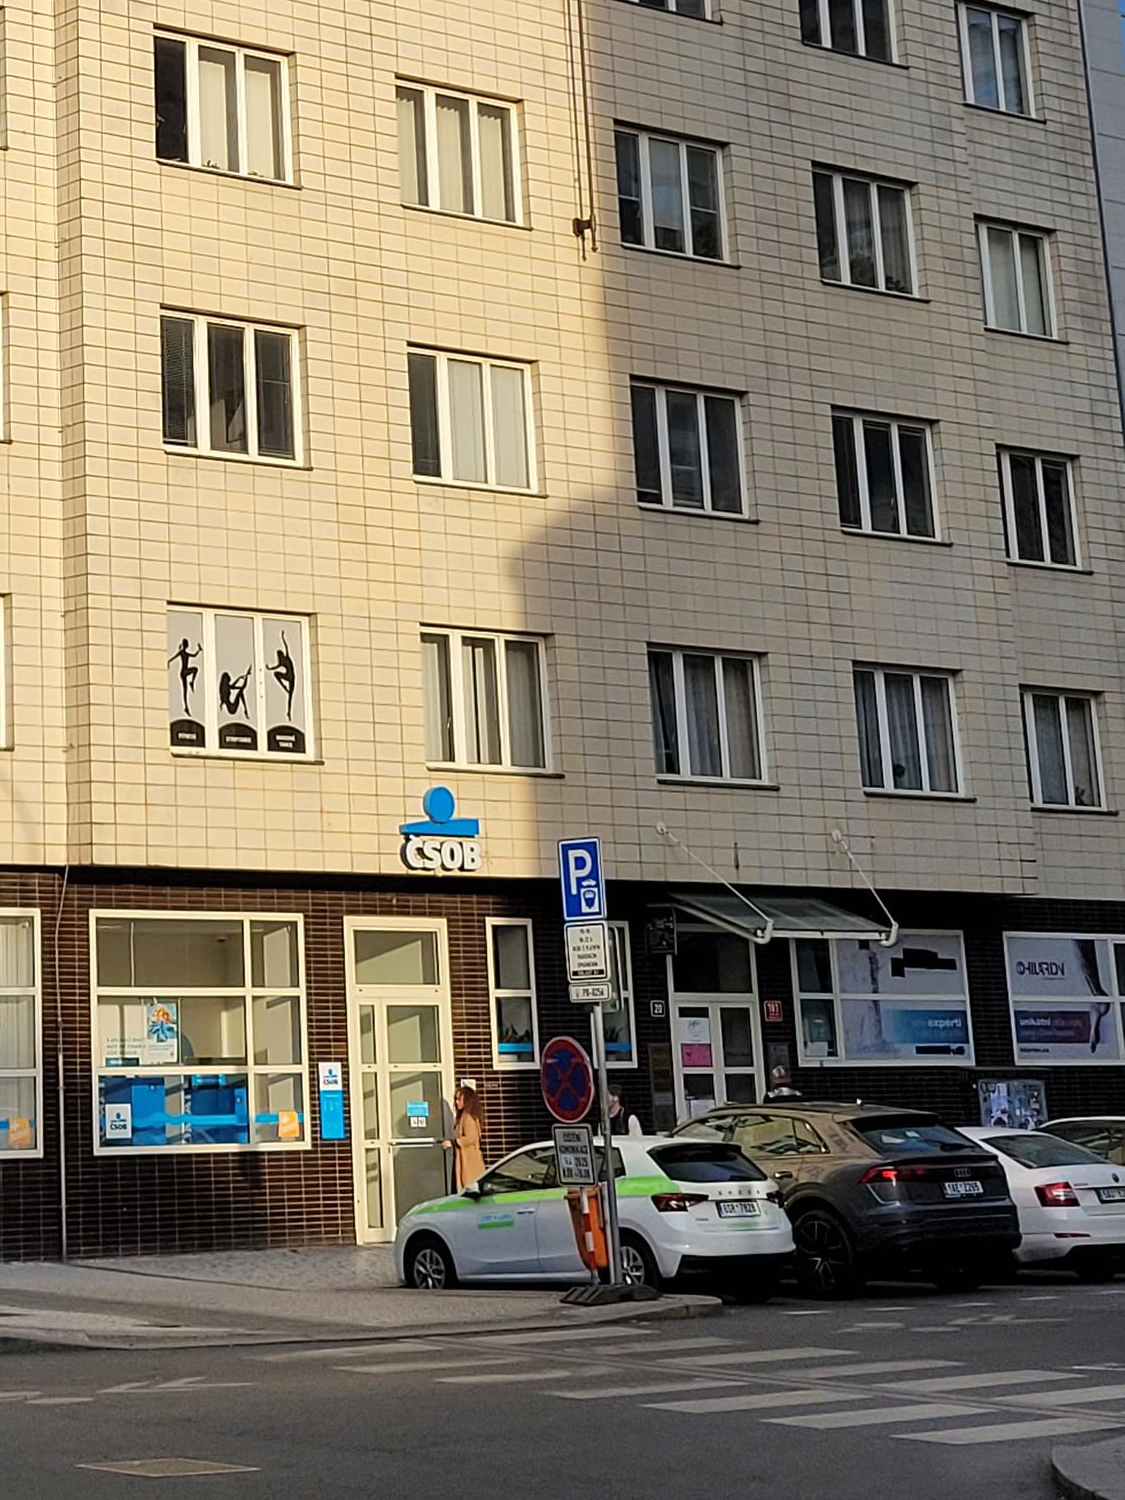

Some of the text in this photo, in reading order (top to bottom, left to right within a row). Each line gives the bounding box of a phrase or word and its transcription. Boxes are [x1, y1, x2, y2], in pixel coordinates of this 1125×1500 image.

[402, 834, 482, 871] ČSOB
[568, 849, 592, 896] P
[109, 1122, 127, 1131] ČSOB
